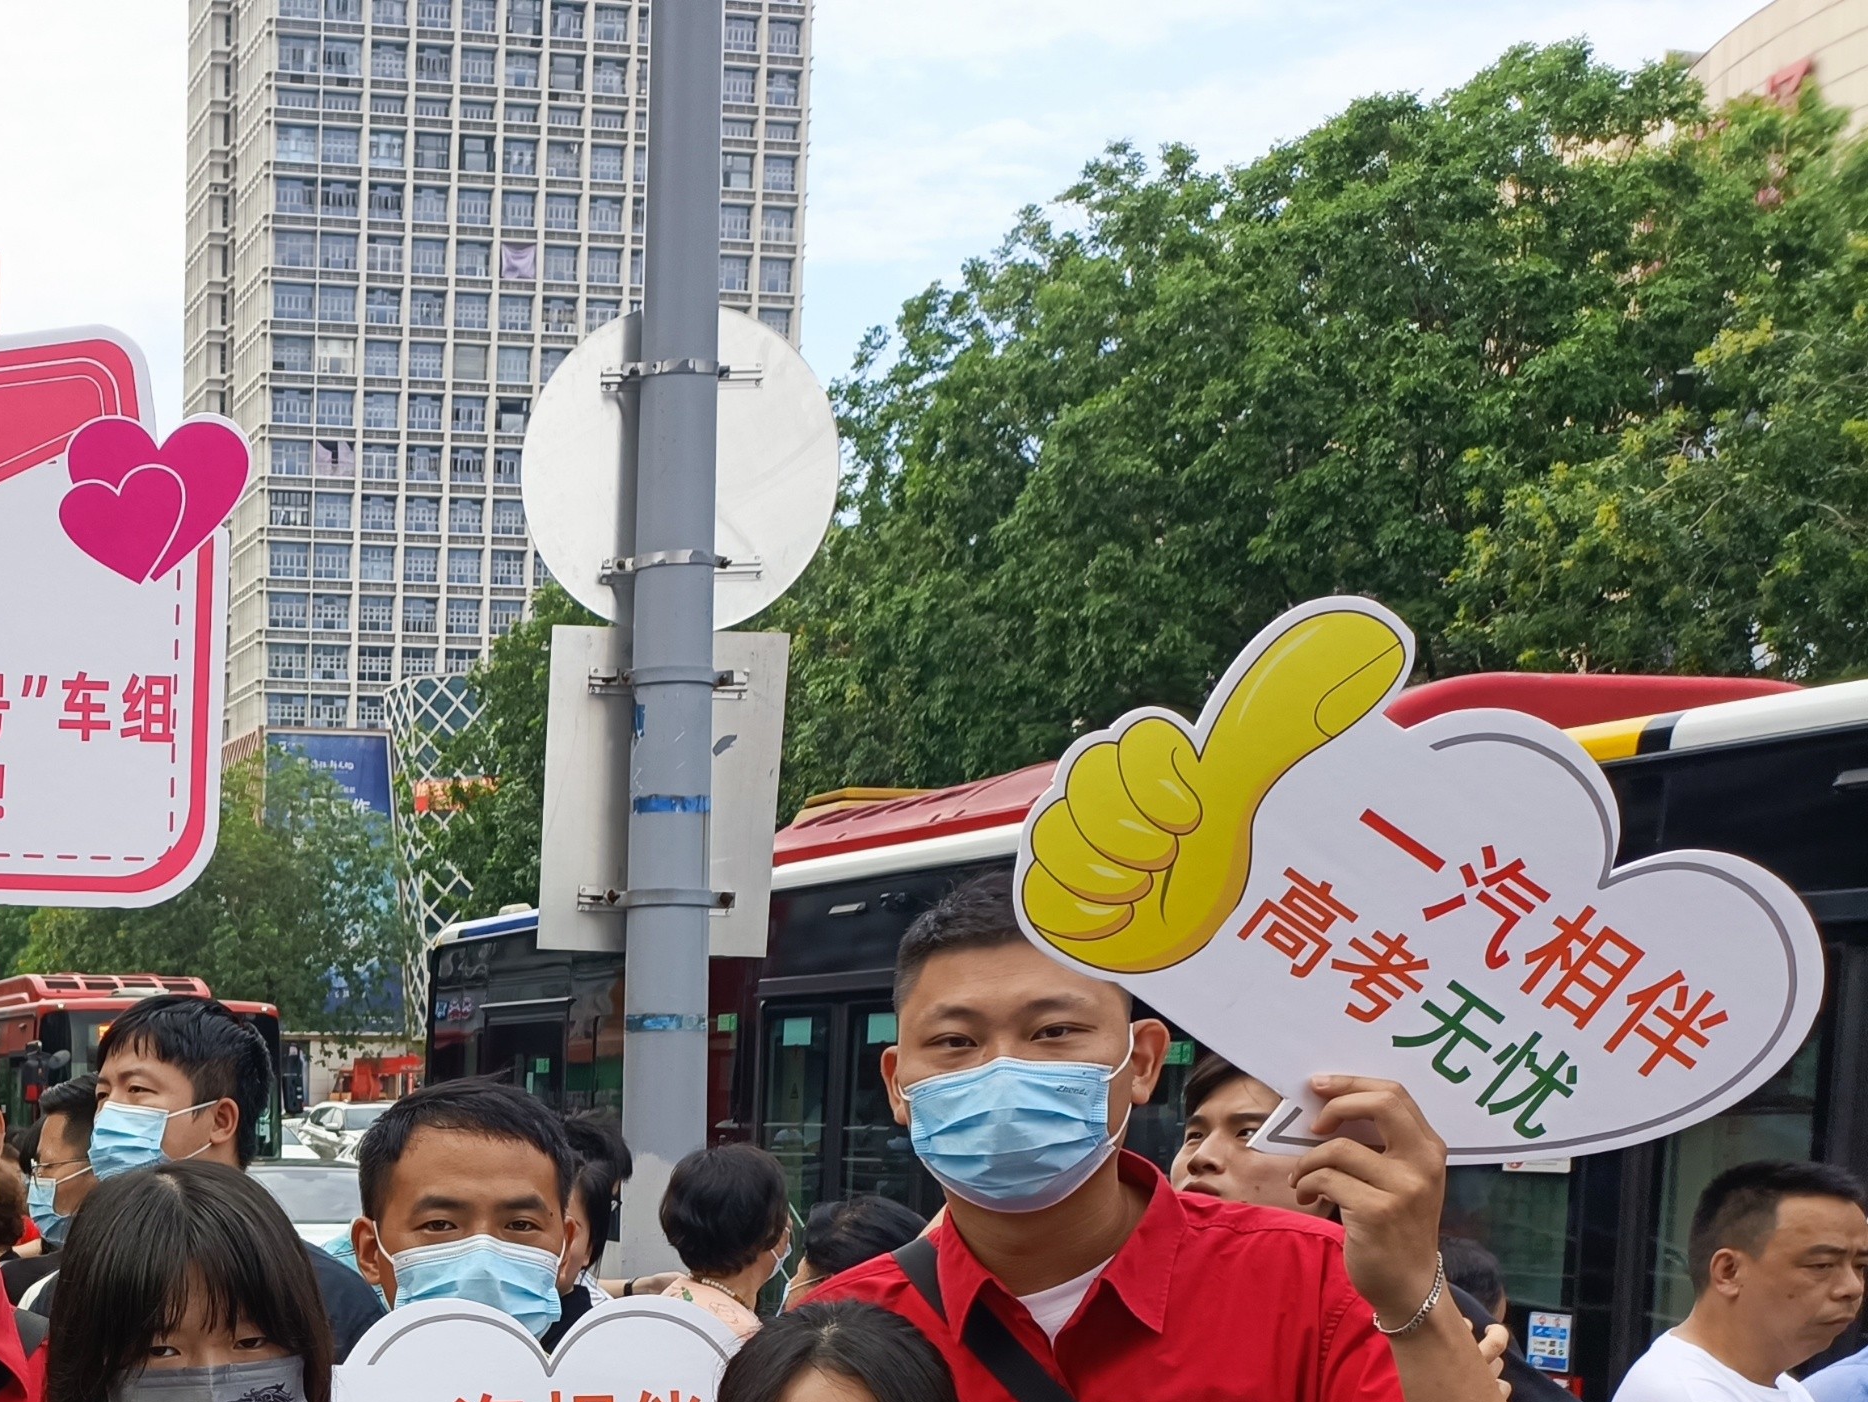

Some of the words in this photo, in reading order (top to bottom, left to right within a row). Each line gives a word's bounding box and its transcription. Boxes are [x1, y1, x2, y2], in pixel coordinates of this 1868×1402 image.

[1238, 866, 1578, 1139] 高考无忧
[1358, 808, 1729, 1077] 一汽相伴
